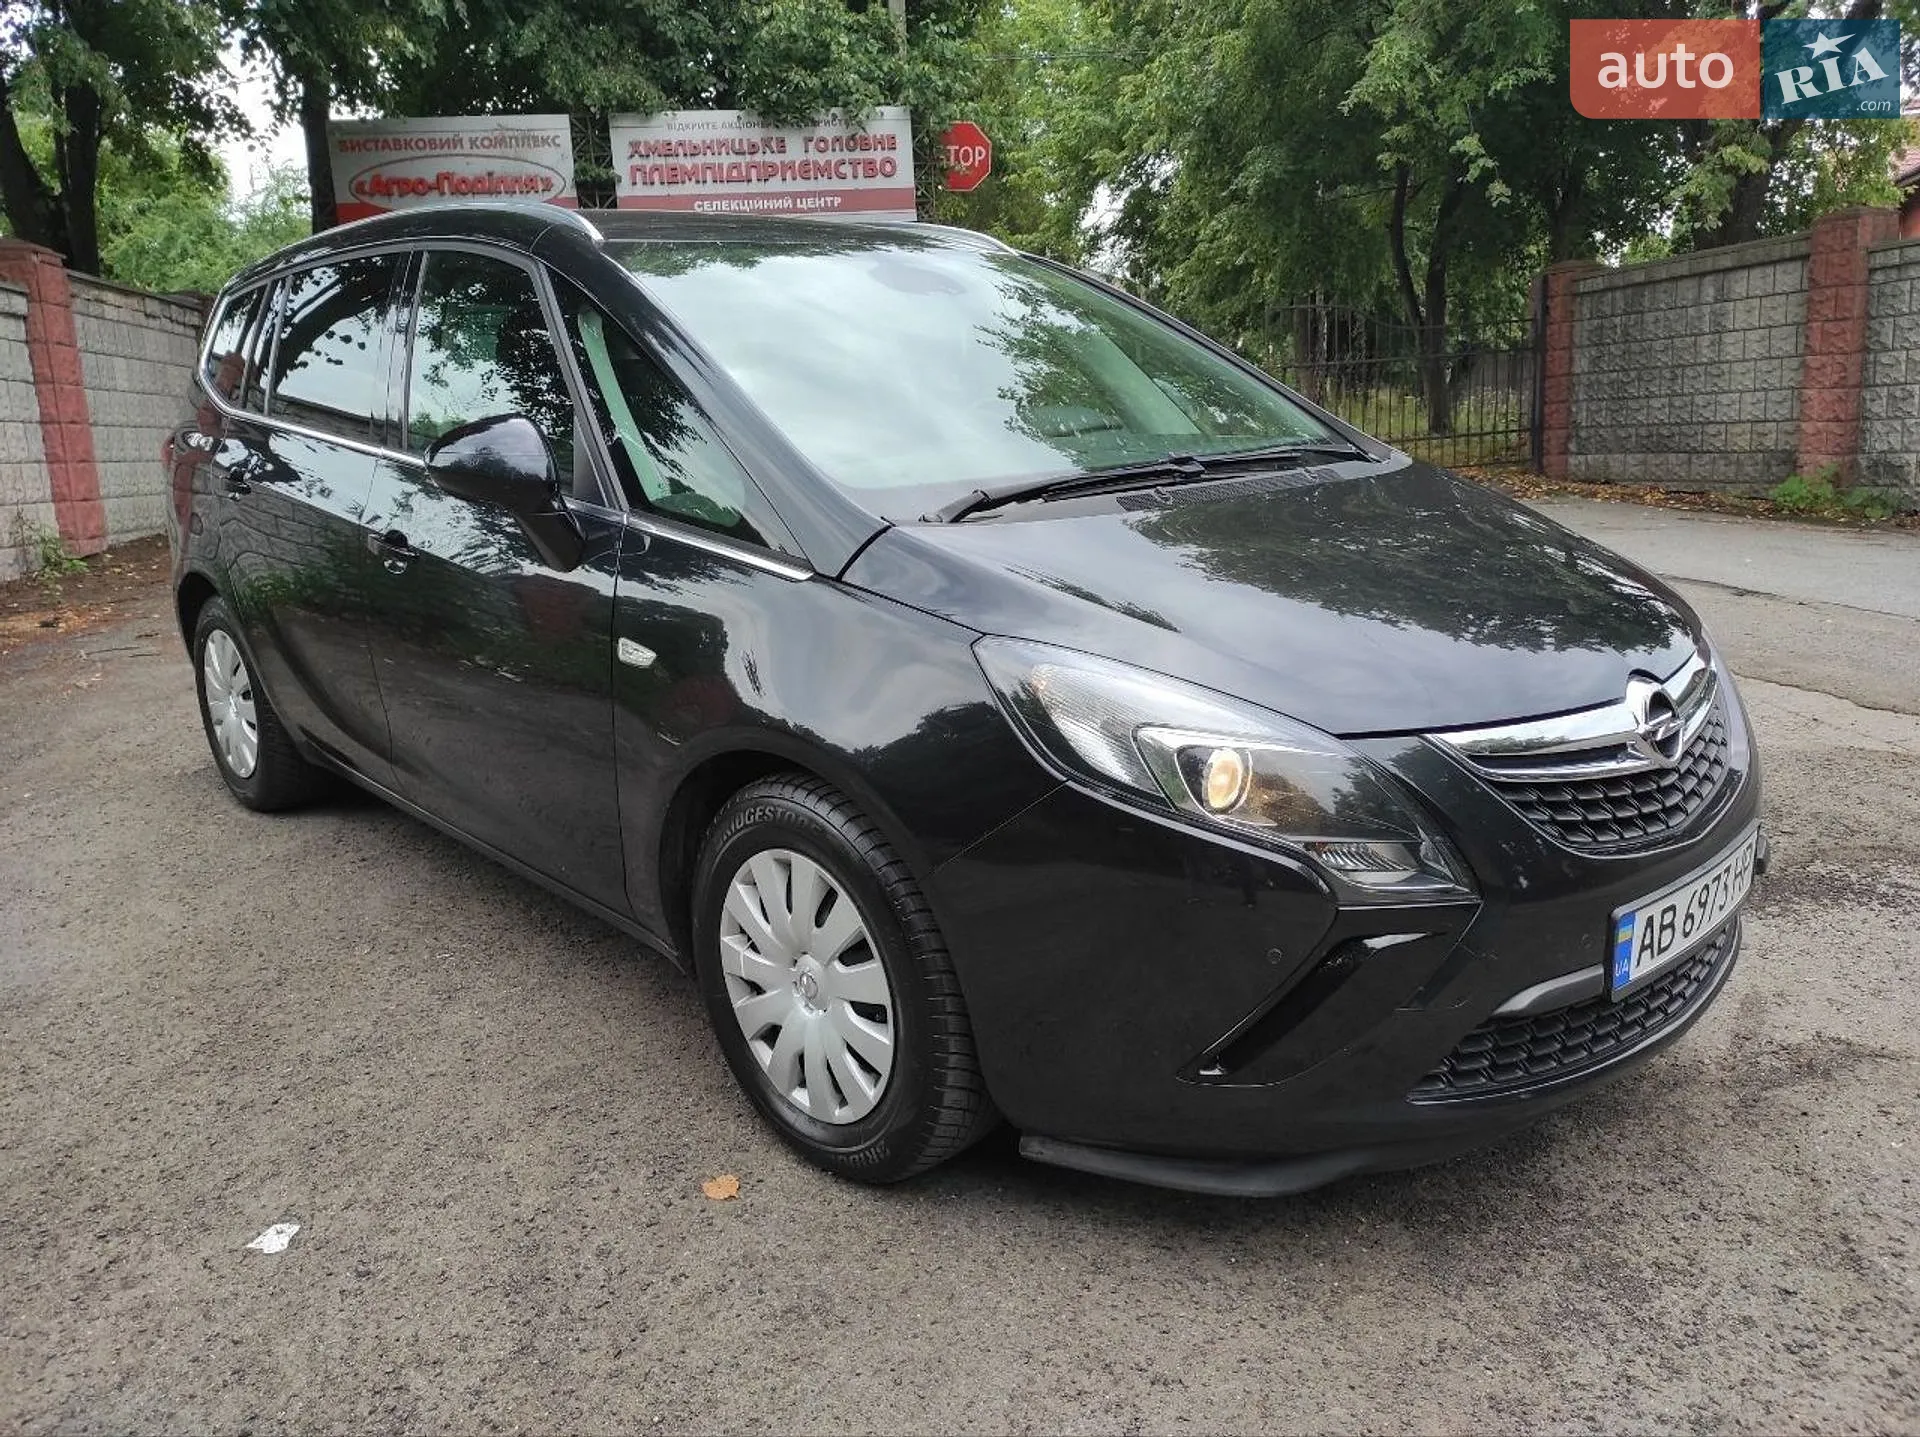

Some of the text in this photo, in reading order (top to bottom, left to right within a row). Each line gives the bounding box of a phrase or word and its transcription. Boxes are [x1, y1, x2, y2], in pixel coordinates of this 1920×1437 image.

[338, 134, 561, 152] ВИСТАВКОВИЙ КОМПЛЕКС
[628, 133, 897, 159] ХМЕЛЬНИЦЬКЕ ГОЛОВНЕ
[630, 156, 897, 185] ПЛЕМПІДПРИЄМСТВО
[693, 196, 842, 213] СЕЛЕКЦІЙНИЙ ЦЕНТР
[1636, 903, 1677, 968] AB
[1682, 864, 1732, 938] 6973
[1615, 959, 1629, 977] UA
